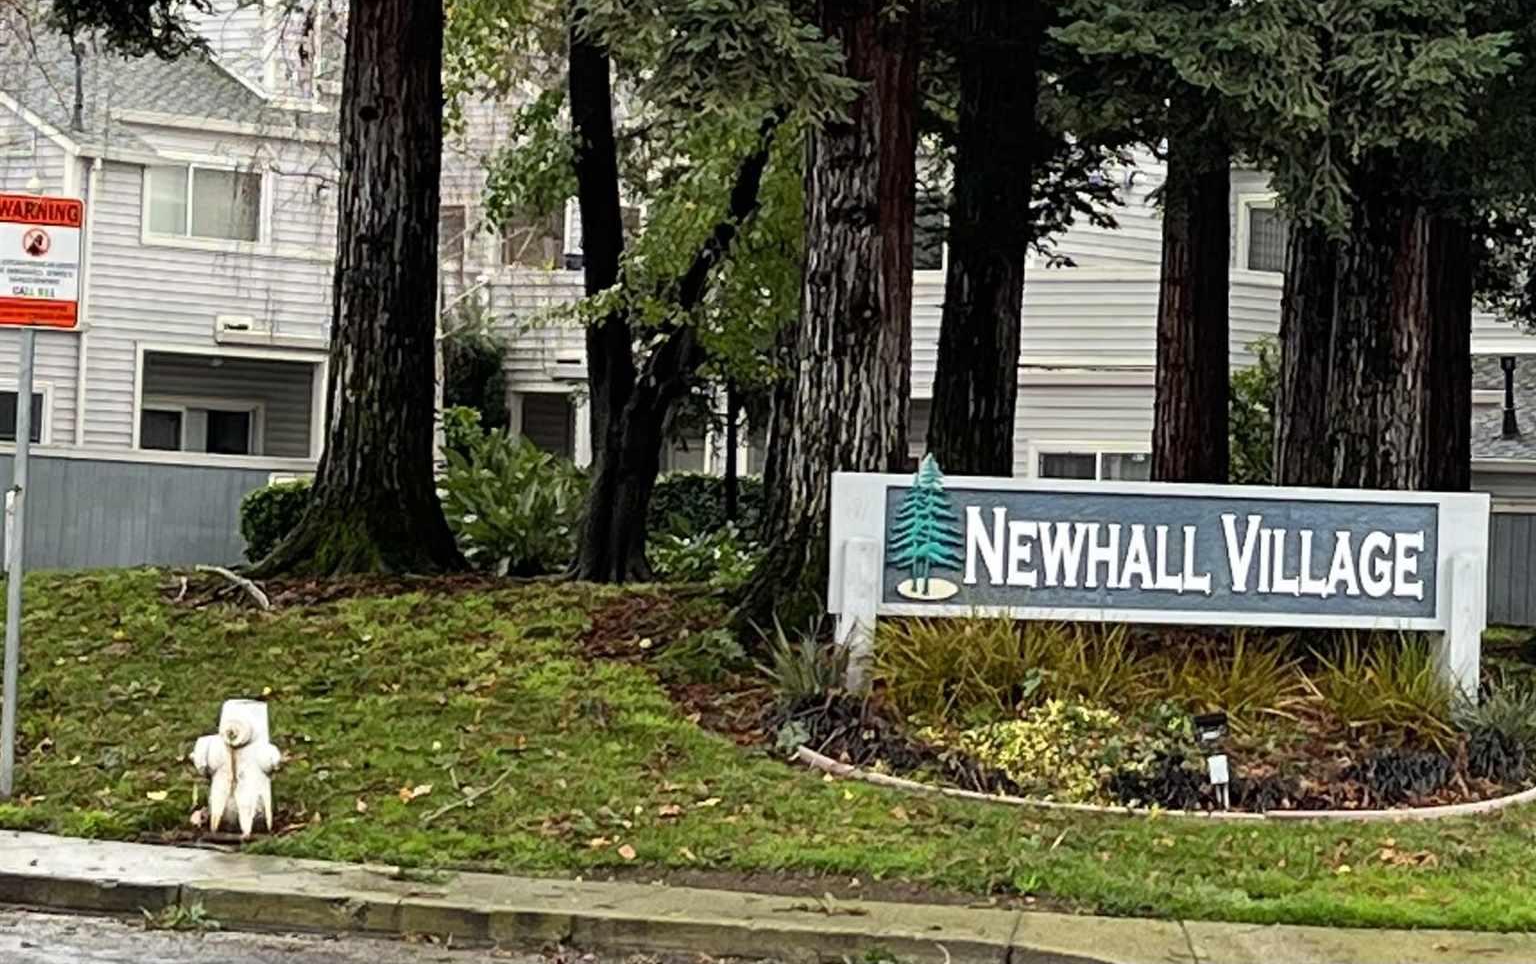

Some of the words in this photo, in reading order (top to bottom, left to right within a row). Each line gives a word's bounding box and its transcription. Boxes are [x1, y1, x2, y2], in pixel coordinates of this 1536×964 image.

[0, 199, 78, 222] WARNING
[963, 506, 1212, 596] NEWHALL
[1221, 514, 1426, 601] VILLAGE
